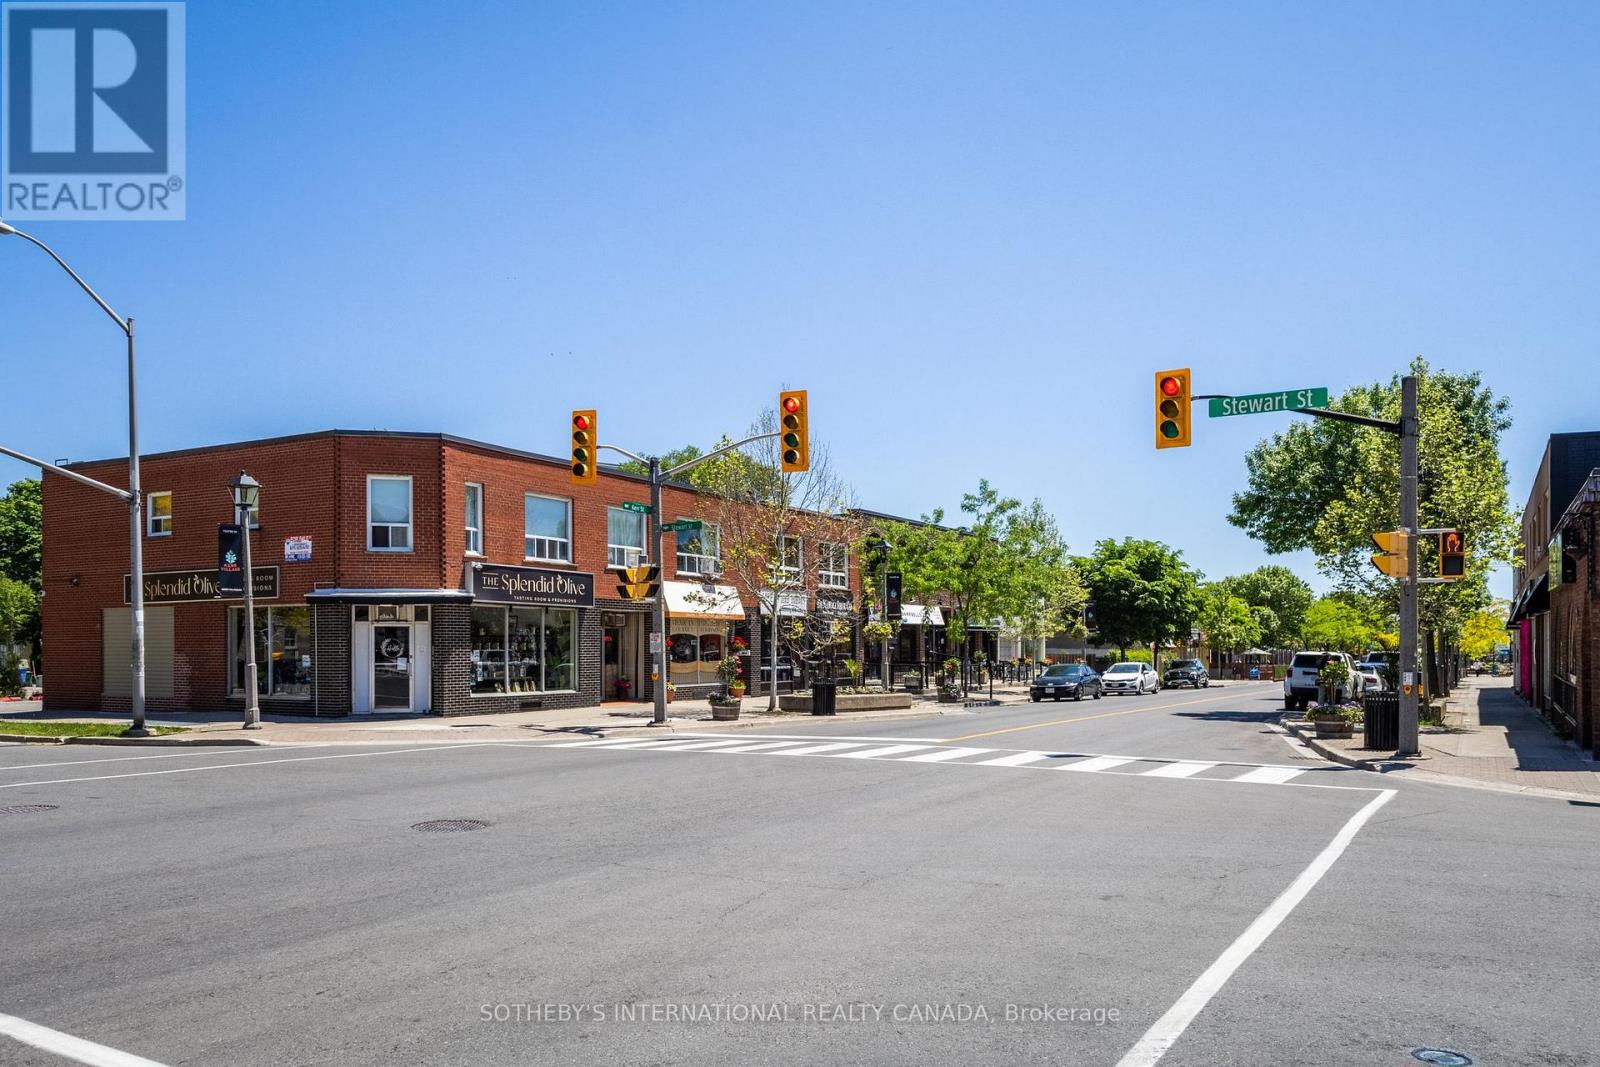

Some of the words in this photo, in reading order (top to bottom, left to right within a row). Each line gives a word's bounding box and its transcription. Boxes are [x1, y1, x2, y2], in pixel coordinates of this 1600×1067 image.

[1222, 392, 1289, 416] Stewart
[1297, 389, 1313, 408] St
[144, 577, 191, 601] Splendid
[193, 574, 222, 595] Olive
[482, 576, 499, 586] THE
[501, 573, 554, 595] Splendid
[556, 574, 586, 596] Olive
